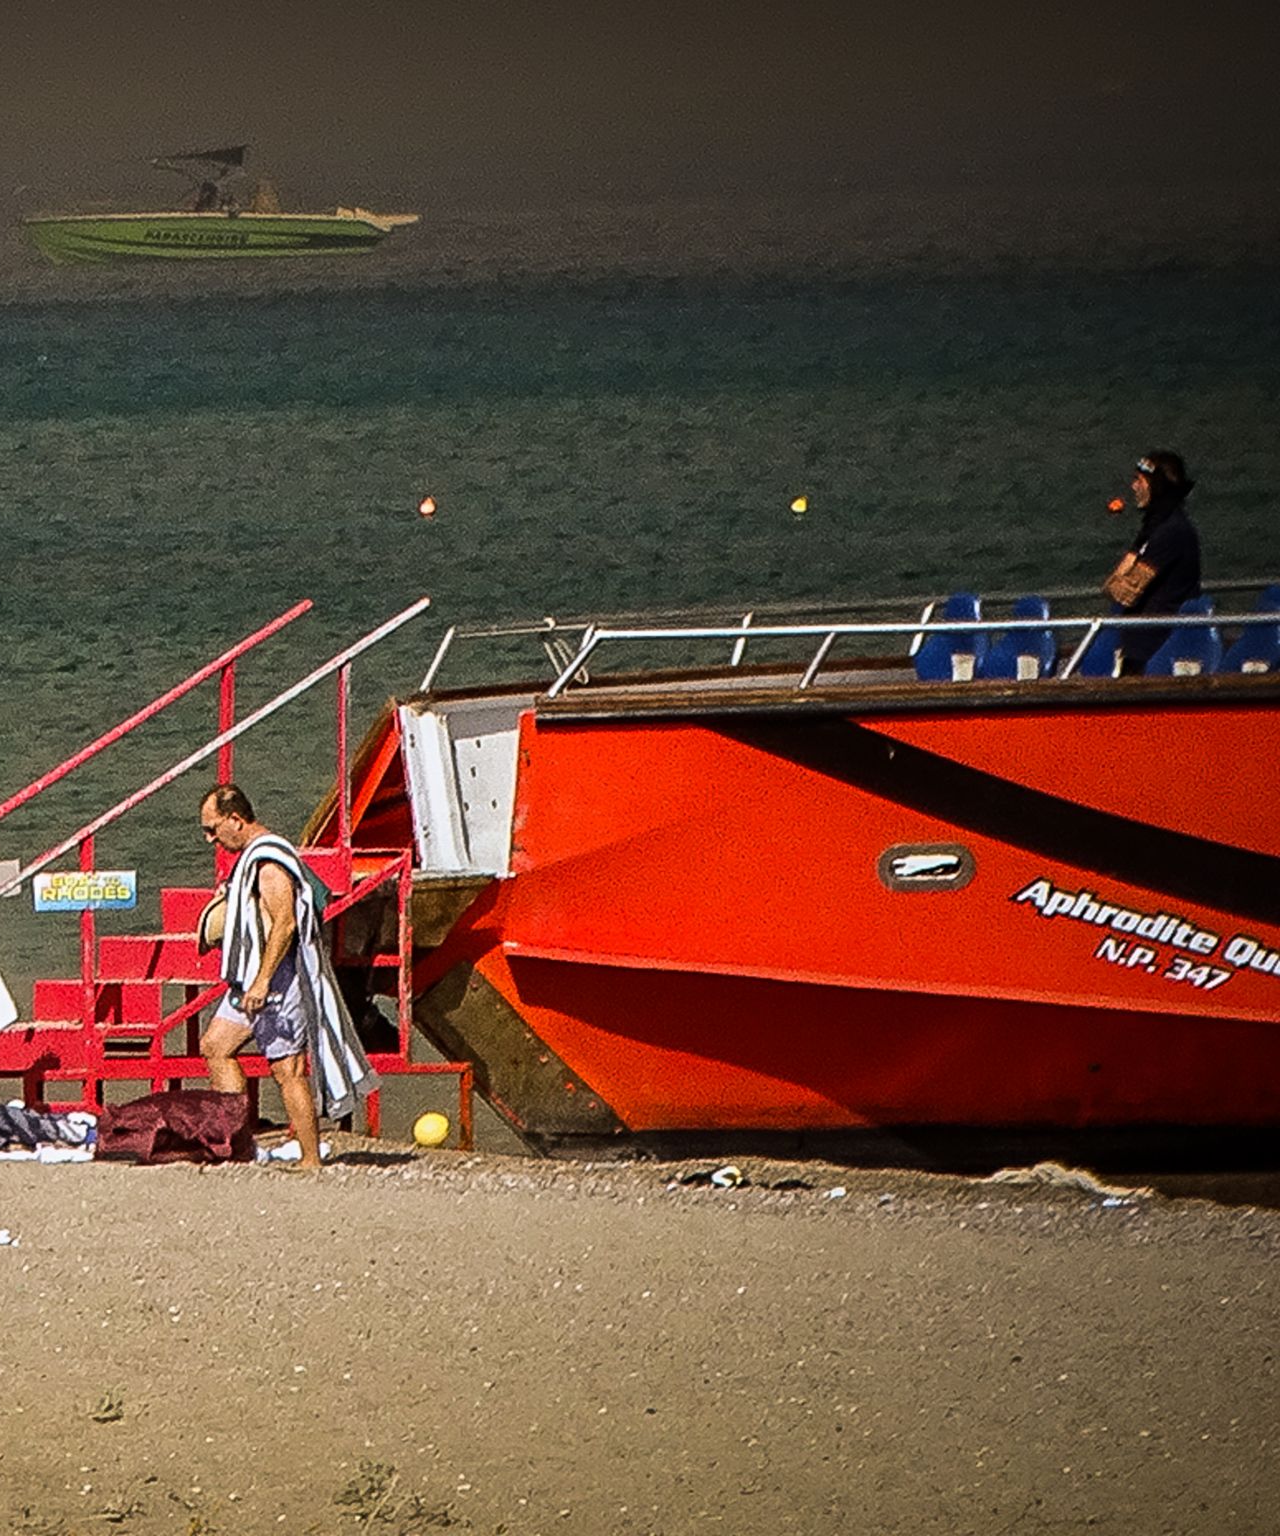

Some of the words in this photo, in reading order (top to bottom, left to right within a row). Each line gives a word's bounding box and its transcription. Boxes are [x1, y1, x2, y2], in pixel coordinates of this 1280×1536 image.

[42, 885, 131, 901] RHODES
[1016, 879, 1220, 955] Aphrodite
[1095, 938, 1158, 974] N.P.
[1164, 957, 1232, 990] 347
